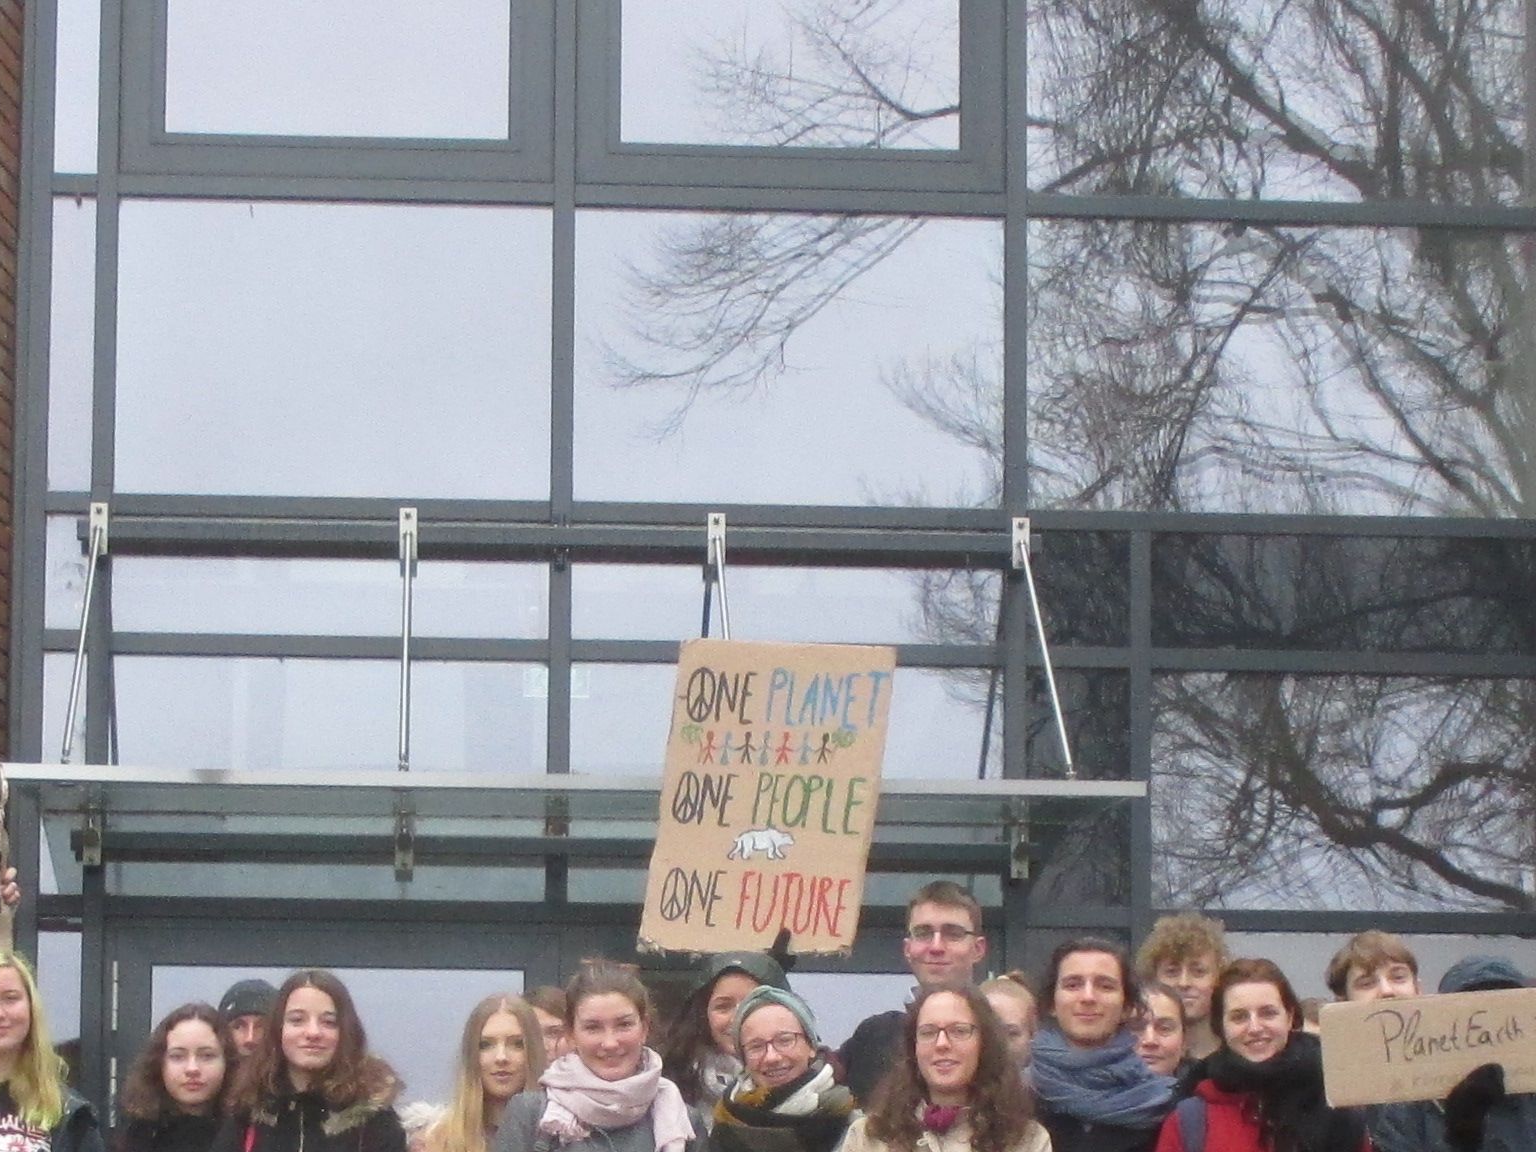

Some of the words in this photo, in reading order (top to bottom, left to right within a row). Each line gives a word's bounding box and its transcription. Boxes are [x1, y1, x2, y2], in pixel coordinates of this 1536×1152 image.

[684, 666, 758, 725] ONE
[766, 666, 891, 731] PLANET
[671, 771, 739, 827] ONE
[751, 771, 867, 835] PEOPLE
[659, 867, 728, 927] ONE
[735, 870, 852, 938] FUTURE
[1365, 1009, 1458, 1063] Planet
[1465, 1010, 1523, 1048] Earth
